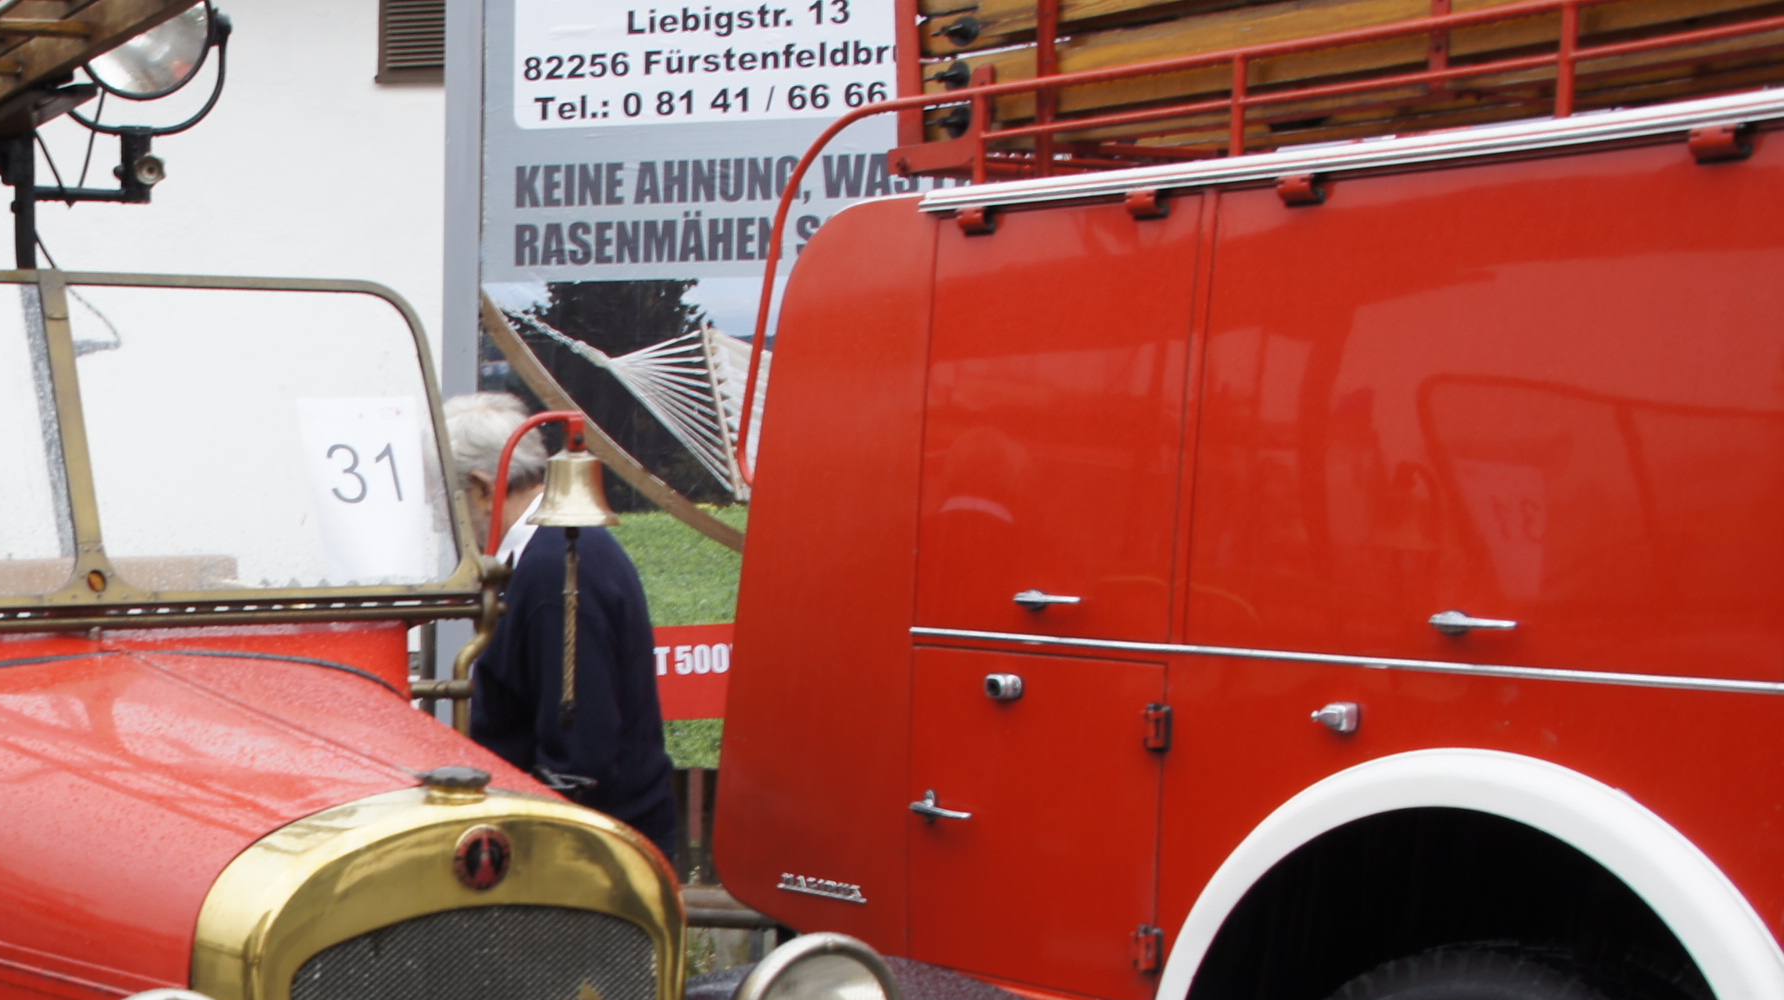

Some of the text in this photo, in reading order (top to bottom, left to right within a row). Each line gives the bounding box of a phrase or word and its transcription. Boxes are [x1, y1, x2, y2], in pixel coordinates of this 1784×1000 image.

[627, 0, 850, 38] Liebigstr. 13
[524, 39, 897, 81] 82256 Fürstenfeldbr
[535, 95, 609, 121] Tel.:
[623, 93, 642, 118] 0
[656, 90, 693, 116] 81
[711, 87, 750, 113] 41
[787, 83, 830, 110] 66
[844, 80, 888, 108] 66
[515, 162, 625, 208] KEINE
[633, 155, 811, 205] AHNUNG,
[326, 443, 403, 504] 31
[674, 643, 733, 675] 500
